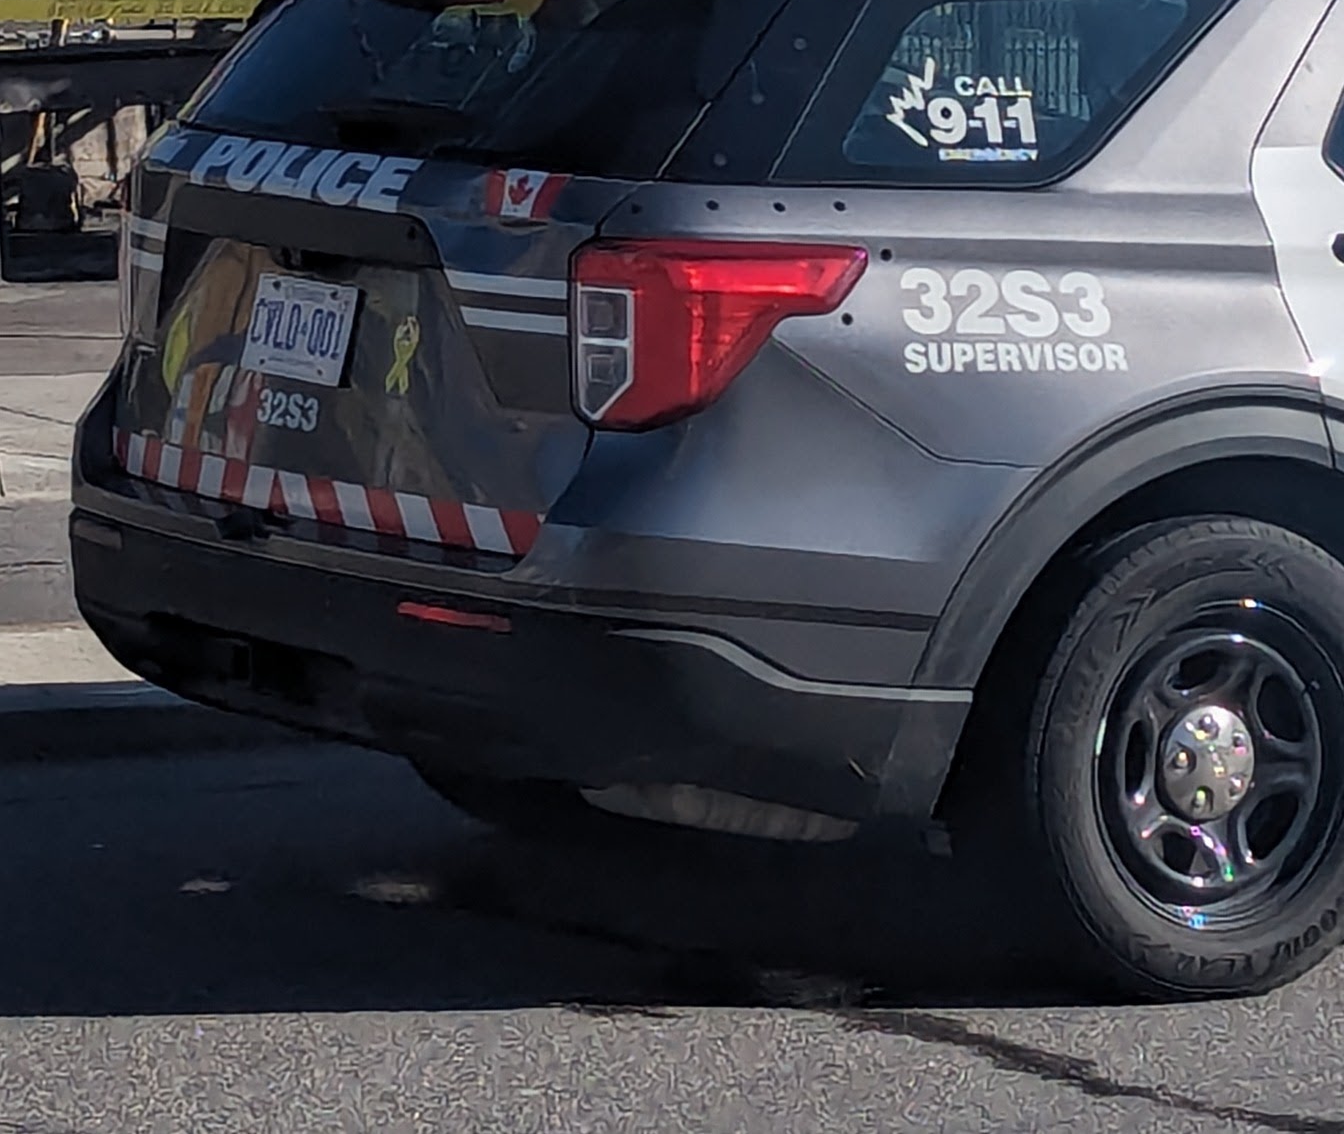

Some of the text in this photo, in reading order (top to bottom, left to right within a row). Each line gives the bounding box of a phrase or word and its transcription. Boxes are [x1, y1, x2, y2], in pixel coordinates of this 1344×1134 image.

[954, 76, 1033, 97] CALL
[188, 134, 426, 214] POLICE
[899, 267, 1112, 338] 32S3
[904, 341, 1128, 374] SUPERVISOR
[256, 387, 320, 433] 32S3
